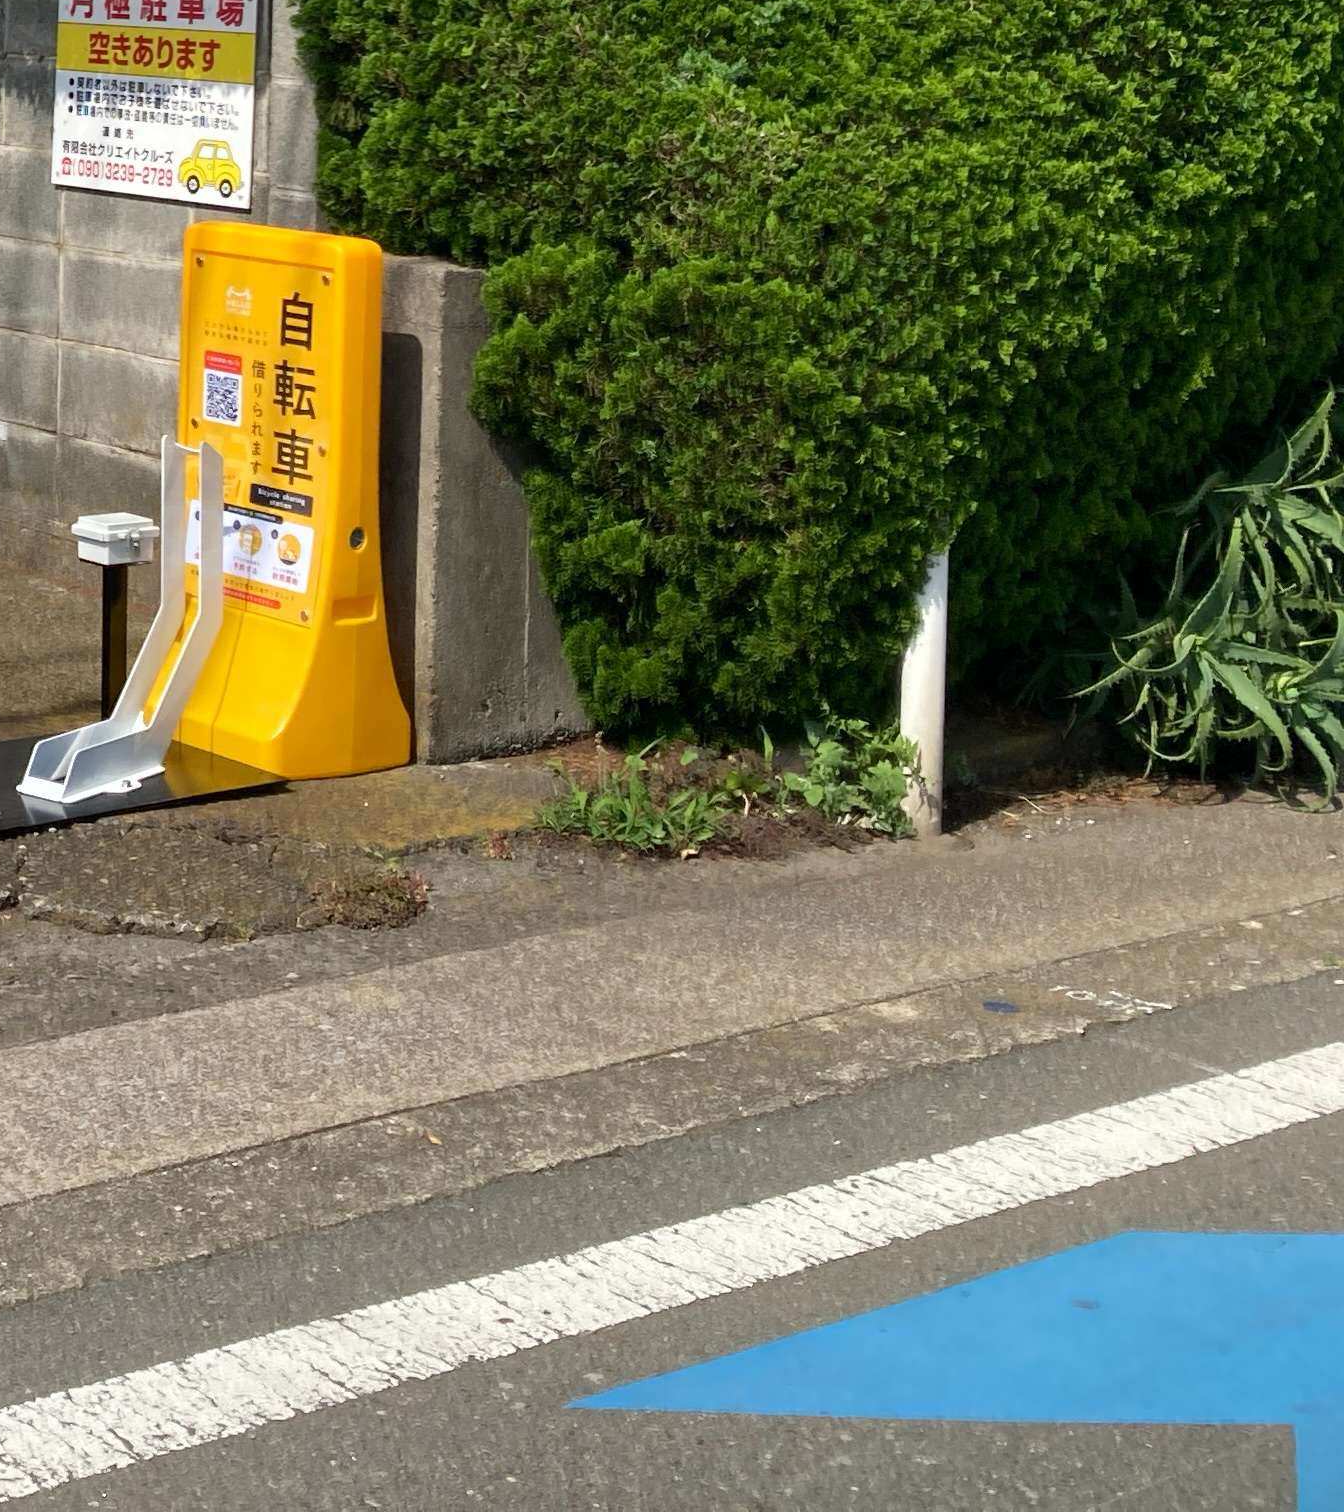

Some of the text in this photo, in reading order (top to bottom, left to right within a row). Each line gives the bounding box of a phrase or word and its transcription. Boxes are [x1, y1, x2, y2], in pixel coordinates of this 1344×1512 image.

[88, 31, 221, 72] 空きあります
[250, 359, 267, 475] 借りられます
[271, 291, 316, 485] 自転車
